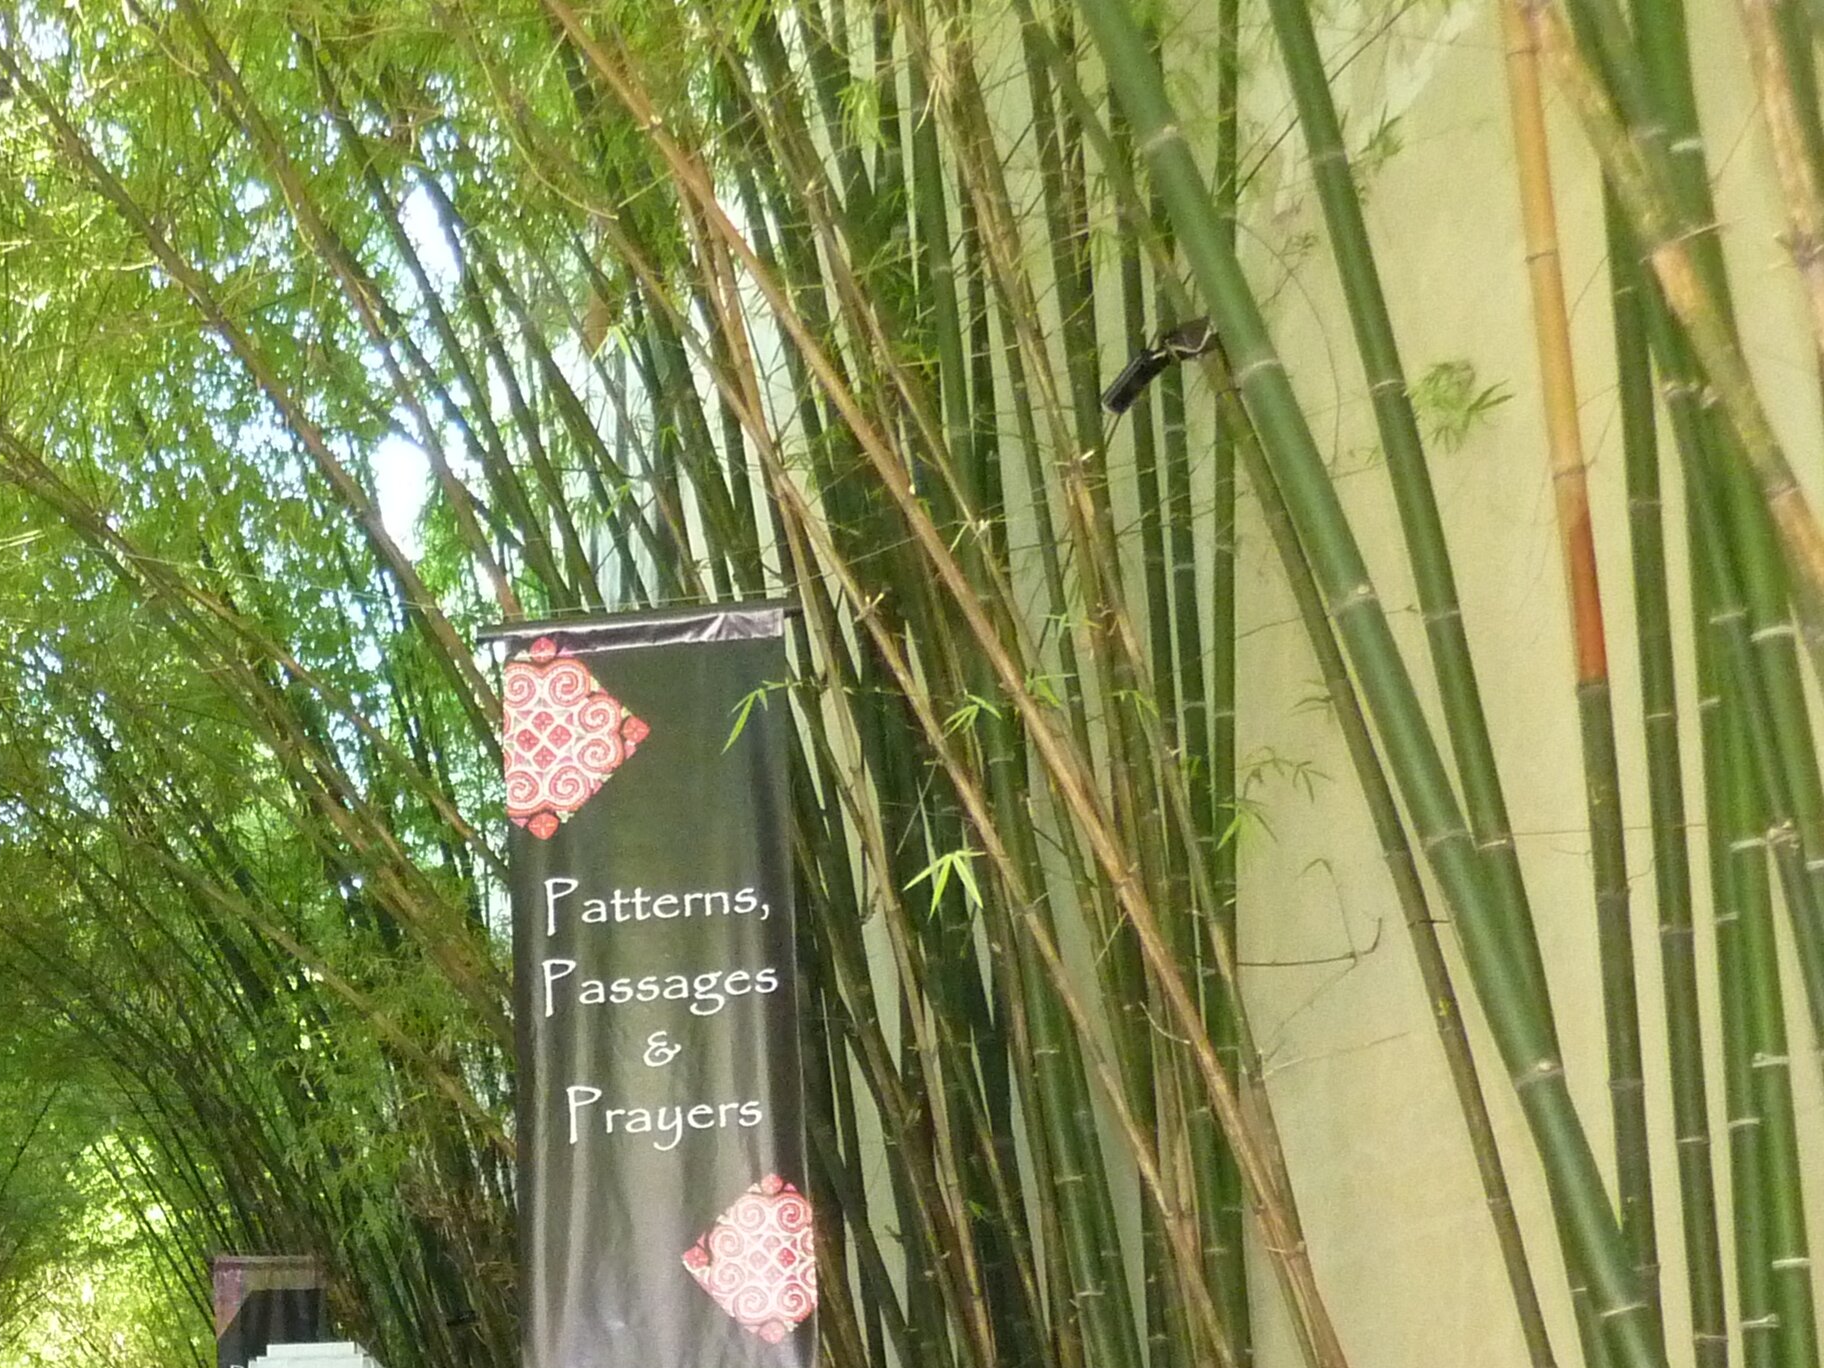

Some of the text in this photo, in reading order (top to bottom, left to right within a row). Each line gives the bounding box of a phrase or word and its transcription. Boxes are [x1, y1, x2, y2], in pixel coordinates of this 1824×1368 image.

[543, 877, 771, 937] Patterns,
[541, 959, 779, 1018] Passages
[643, 1030, 682, 1067] &
[566, 1085, 764, 1151] Prayers
